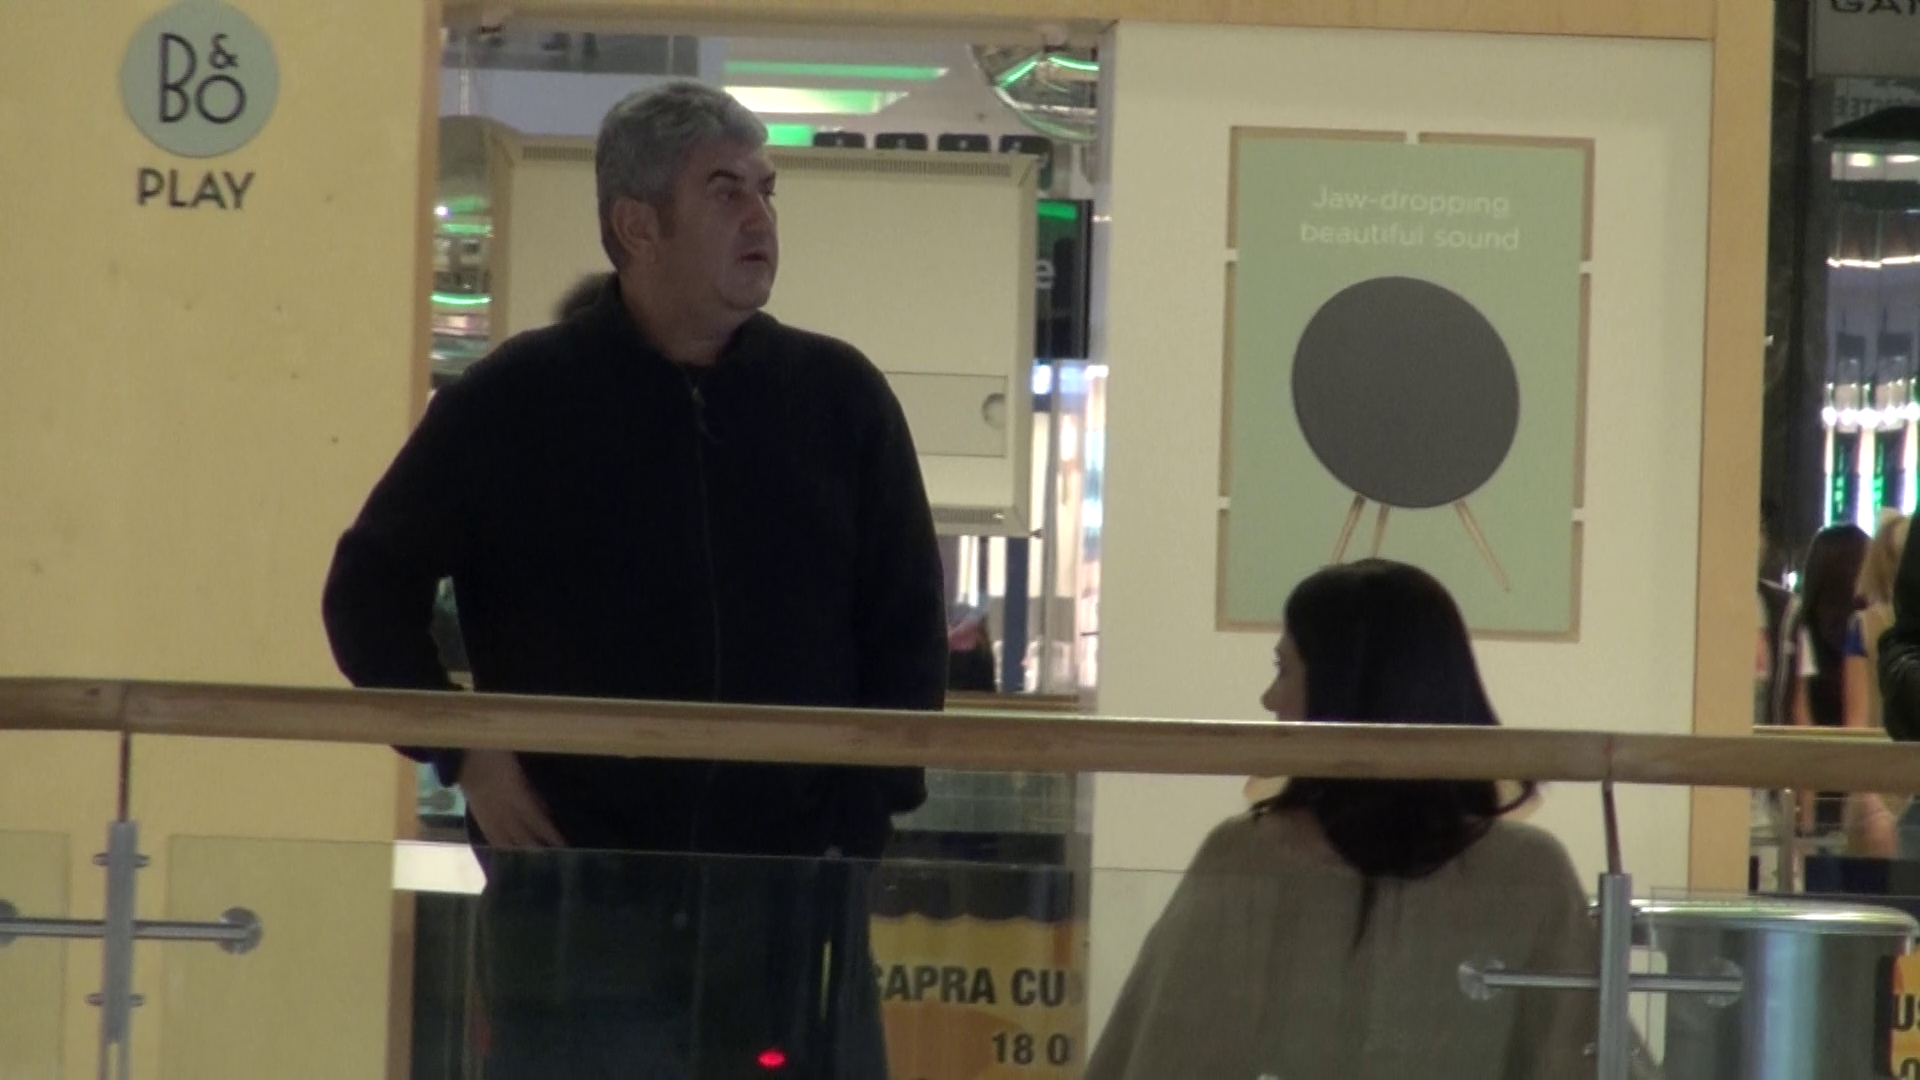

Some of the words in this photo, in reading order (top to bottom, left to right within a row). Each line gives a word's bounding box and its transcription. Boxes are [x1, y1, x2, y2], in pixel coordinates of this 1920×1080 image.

[137, 167, 256, 210] PLAY
[1312, 184, 1510, 219] Jaw-dropping
[1300, 222, 1424, 245] beautiful
[1434, 226, 1520, 250] sound
[1011, 967, 1066, 1007] CU
[992, 1032, 1034, 1066] 18
